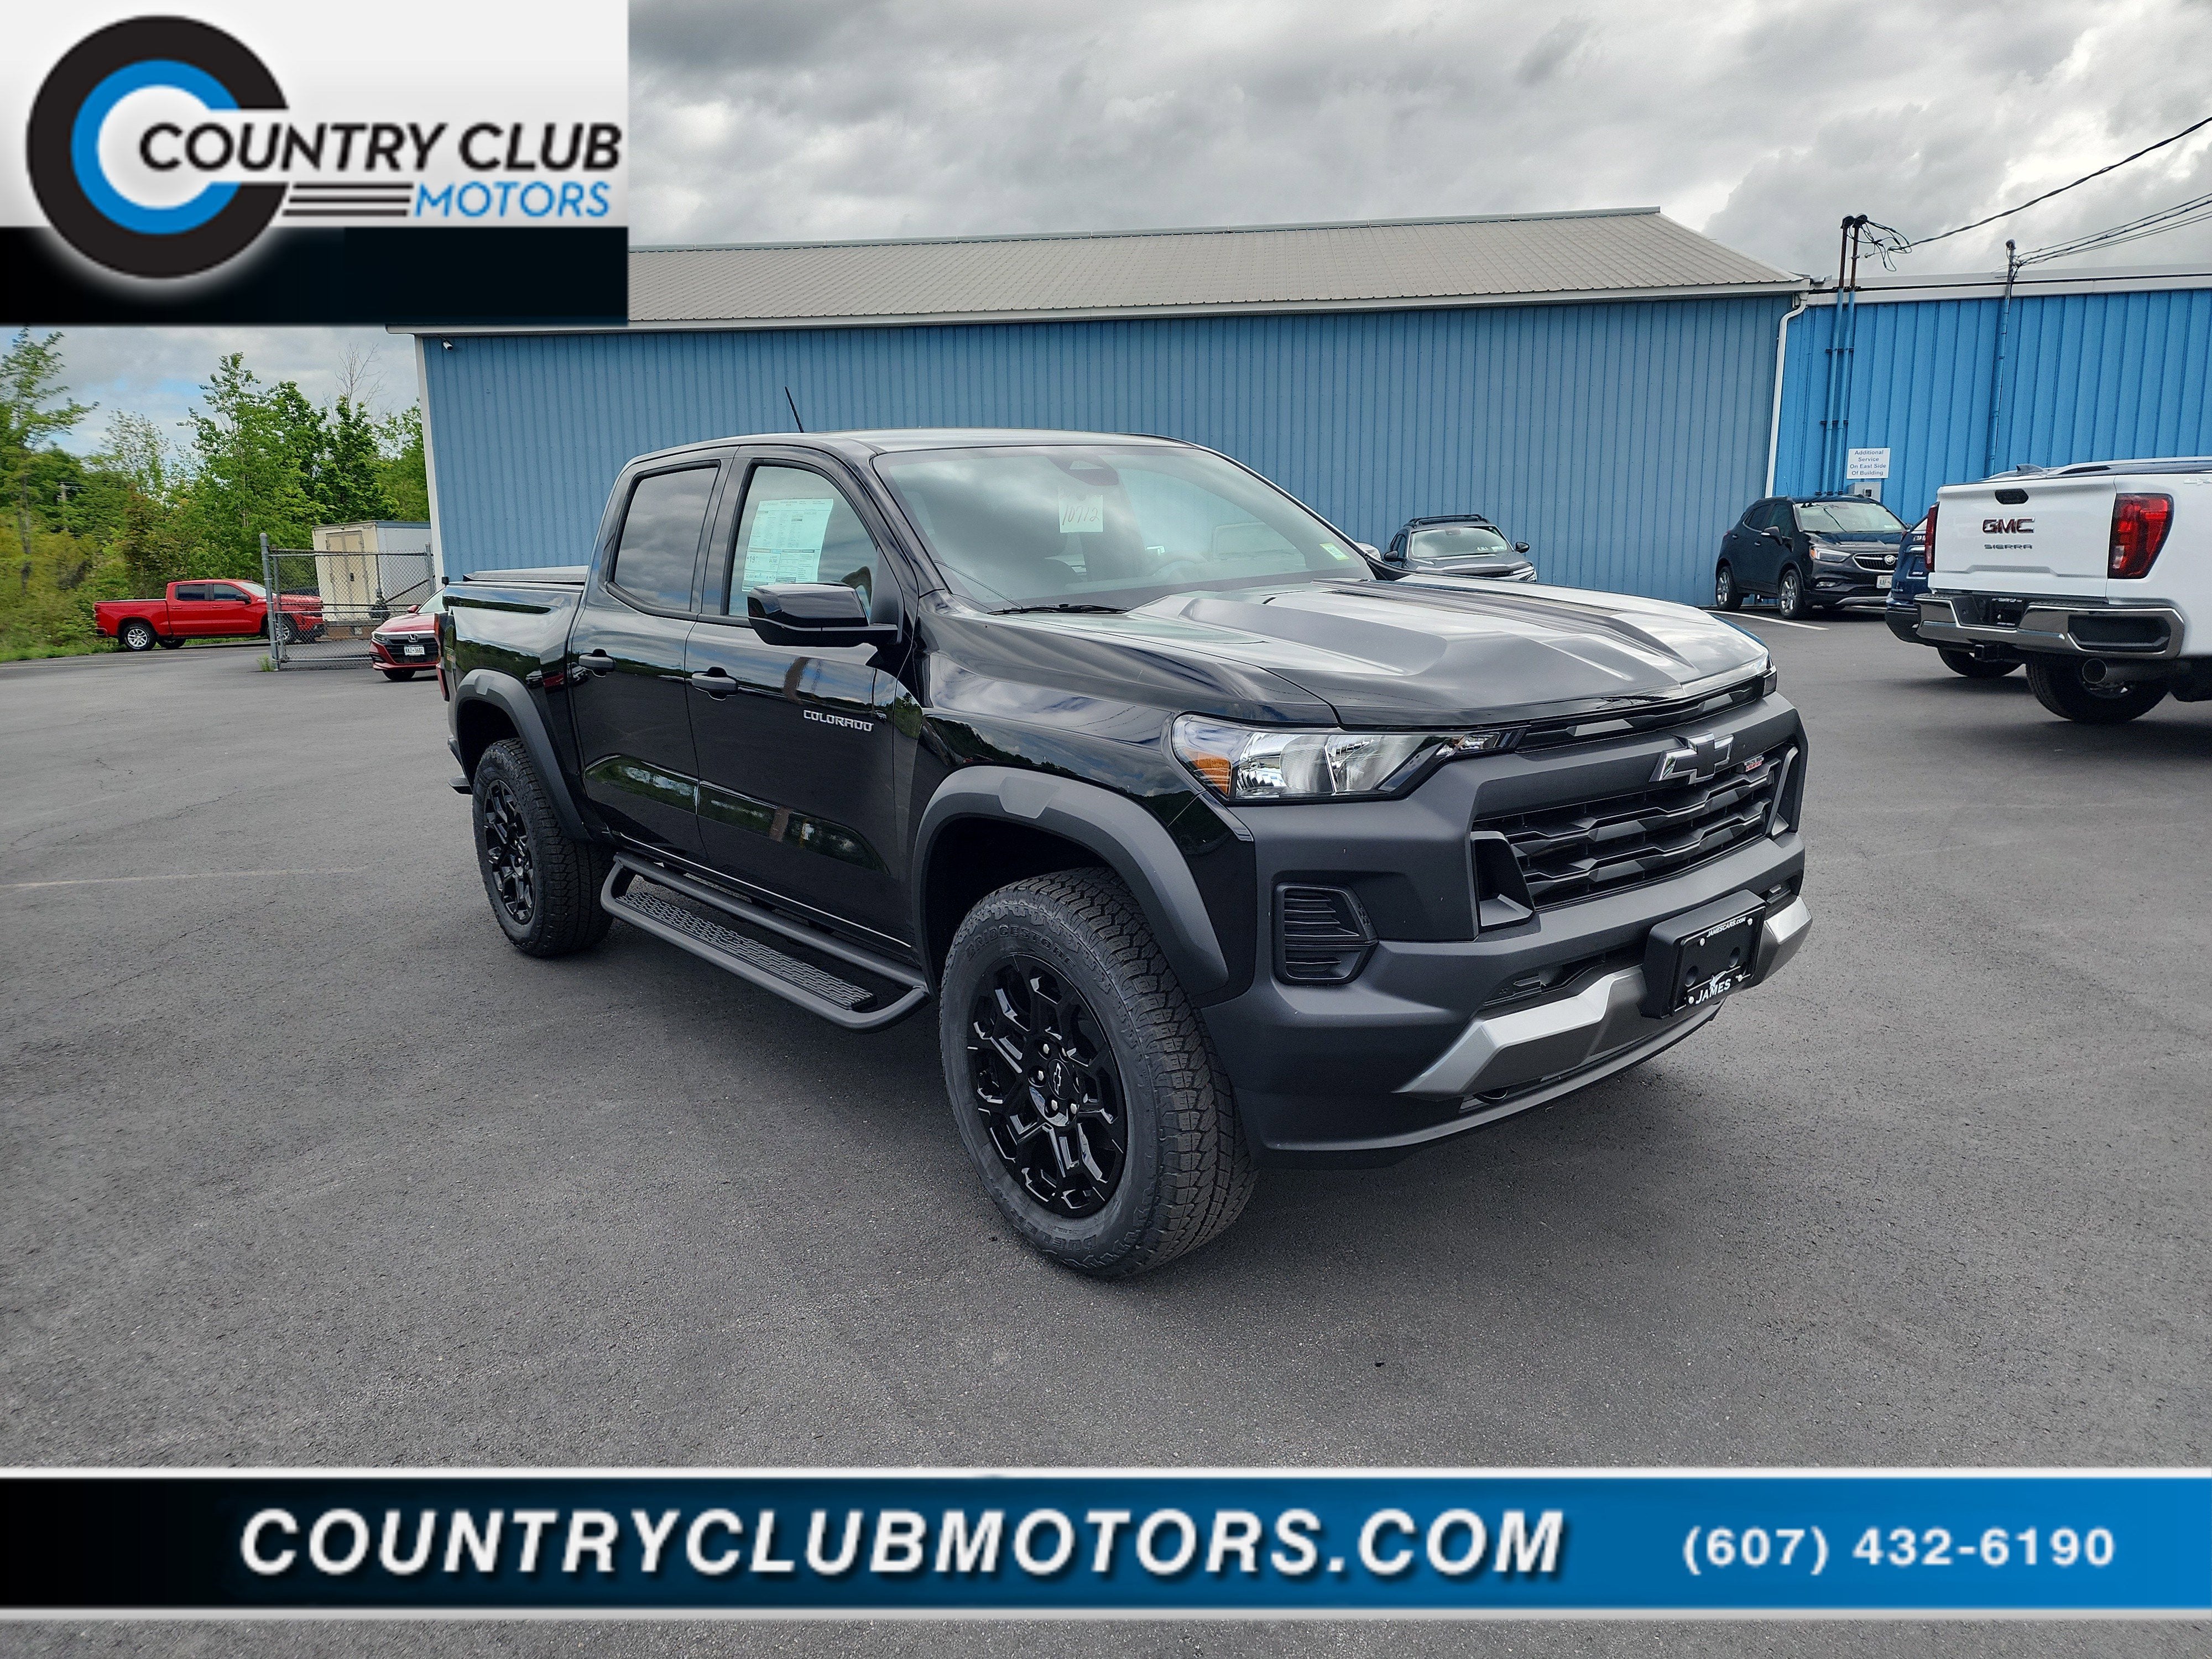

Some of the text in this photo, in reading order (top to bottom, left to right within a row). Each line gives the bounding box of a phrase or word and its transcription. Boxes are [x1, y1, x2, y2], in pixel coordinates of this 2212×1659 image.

[1982, 517, 2035, 534] GMC
[804, 709, 873, 732] COLORADO
[1706, 916, 1746, 938] JAMESCARS.COM
[967, 924, 1076, 969] BRIDGESTONE
[1695, 978, 1731, 1005] JAMES
